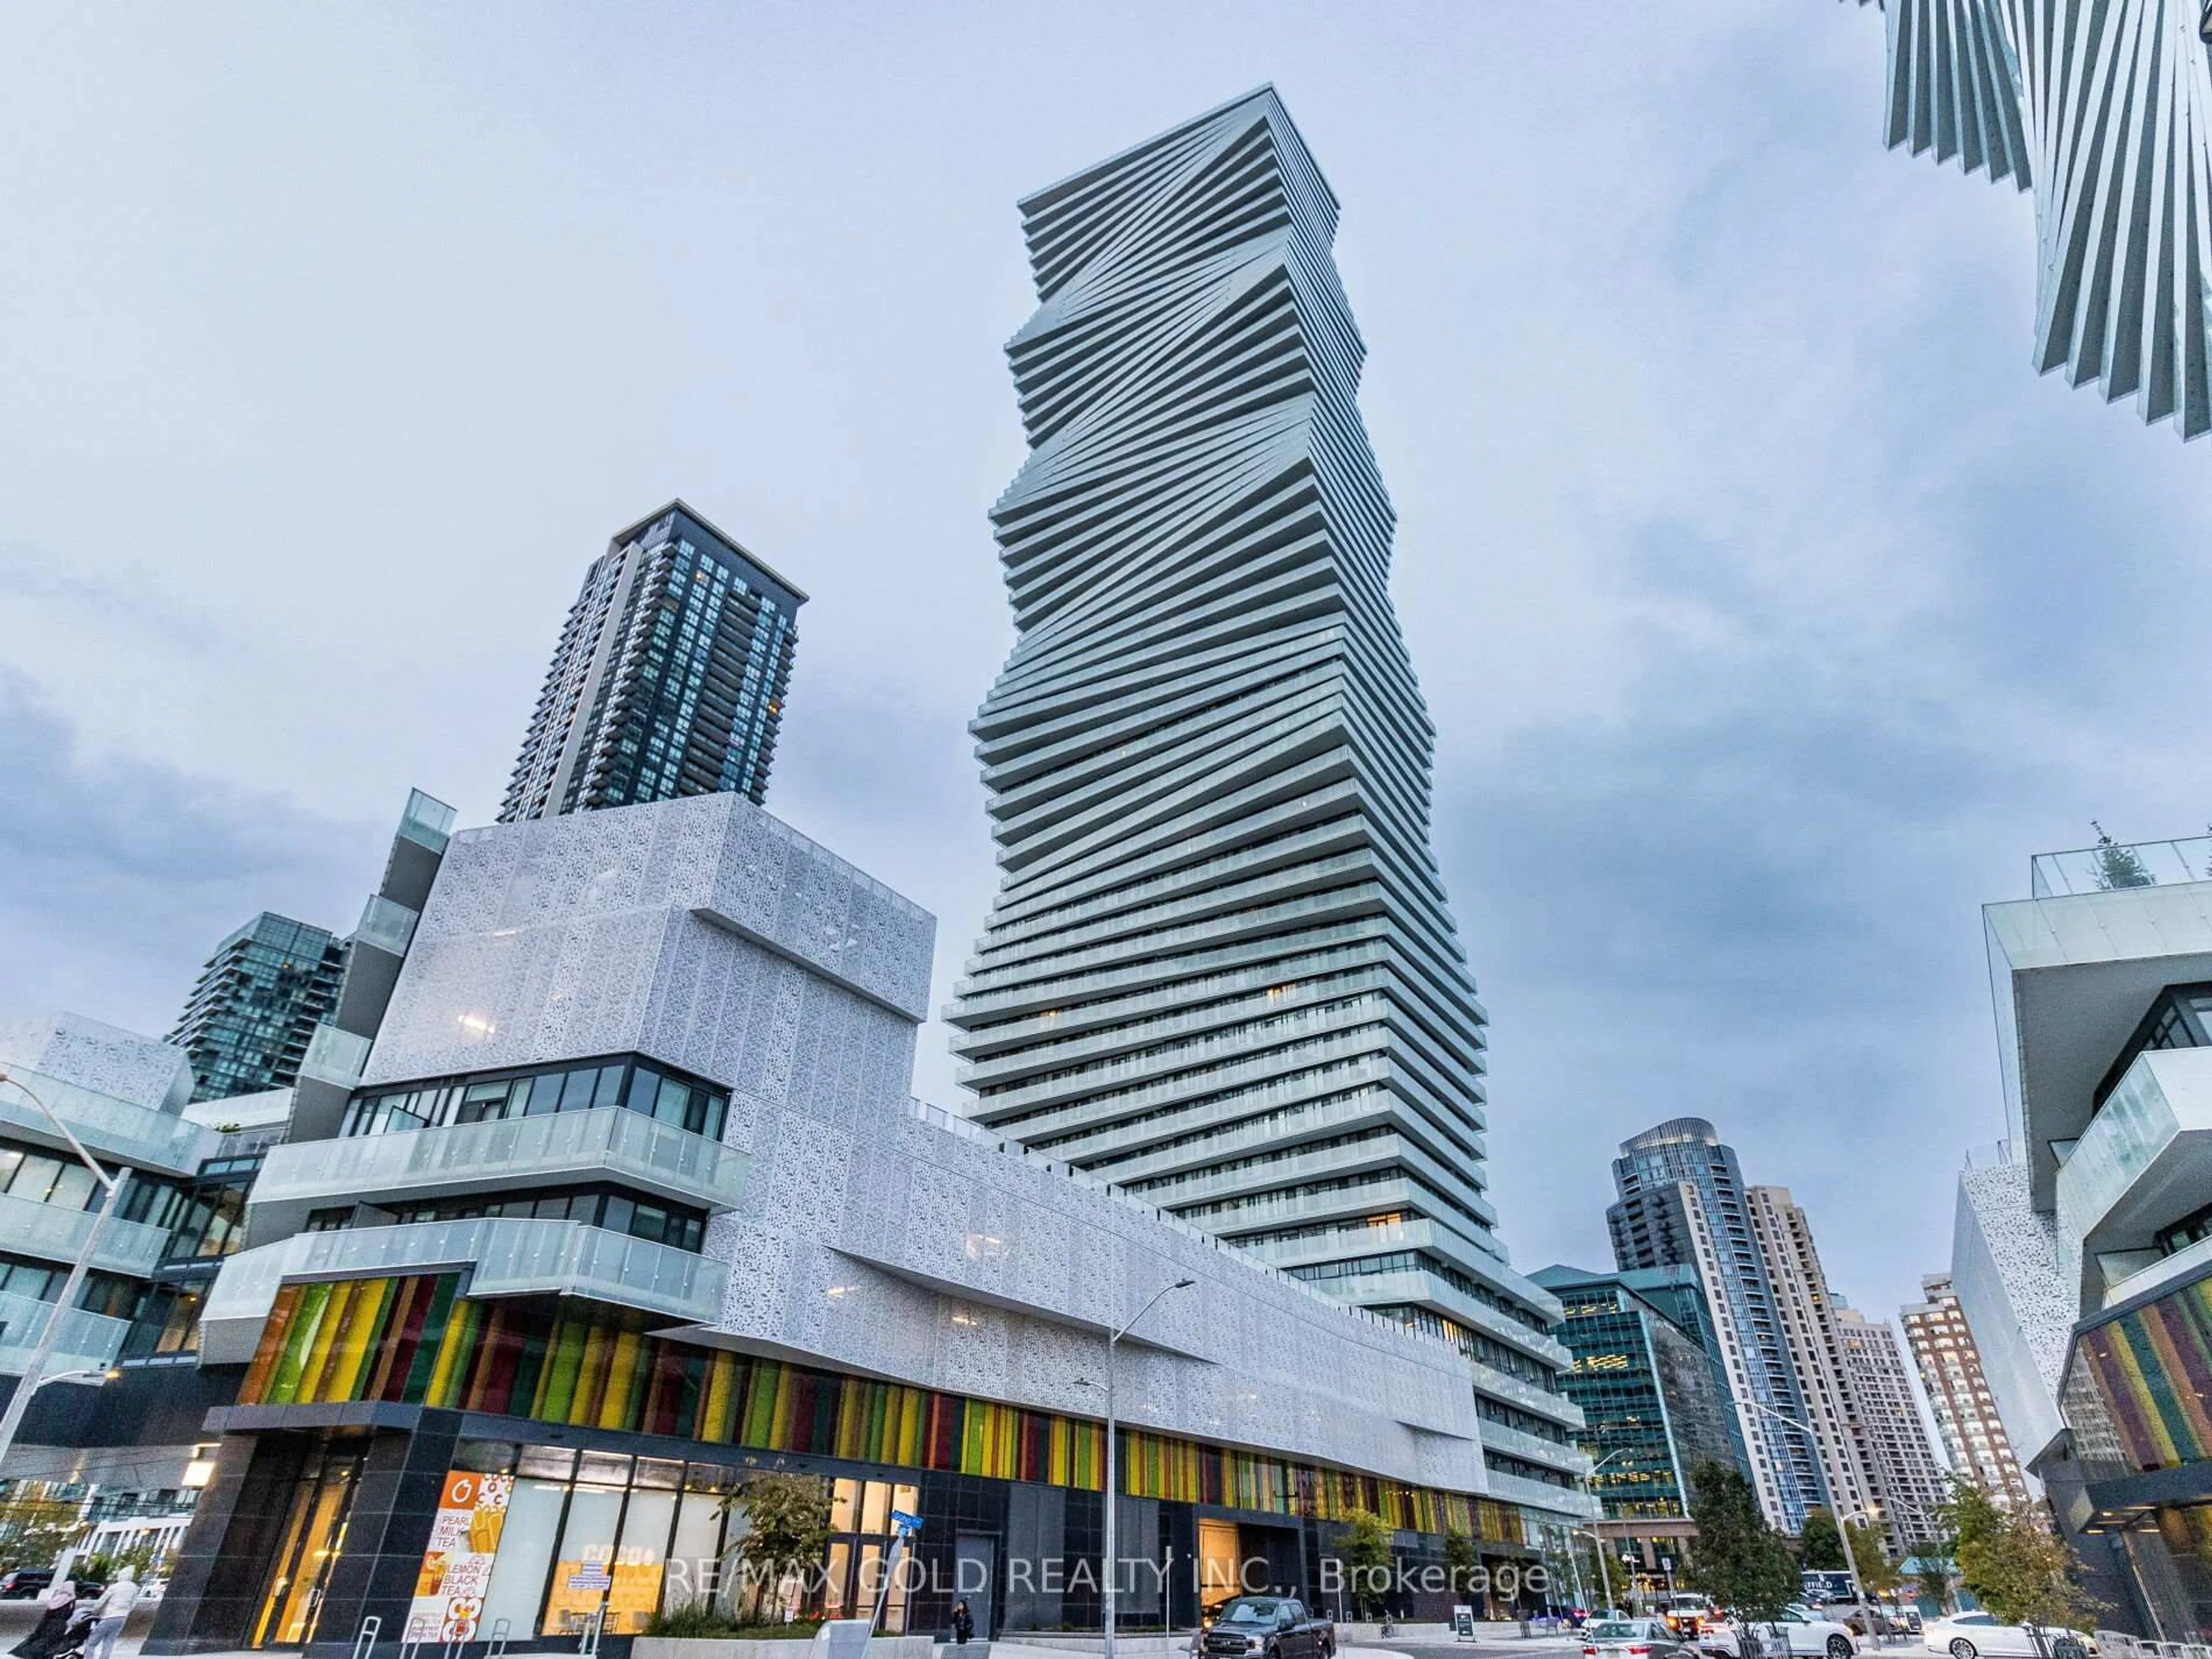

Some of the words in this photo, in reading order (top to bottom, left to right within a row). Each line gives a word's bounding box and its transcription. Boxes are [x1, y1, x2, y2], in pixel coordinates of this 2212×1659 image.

[442, 1516, 471, 1526] PEARL
[439, 1526, 467, 1537] MILK
[437, 1537, 456, 1547] TEA
[447, 1565, 480, 1574] LEMON
[444, 1575, 478, 1585] BLACK
[441, 1586, 460, 1595] TEA
